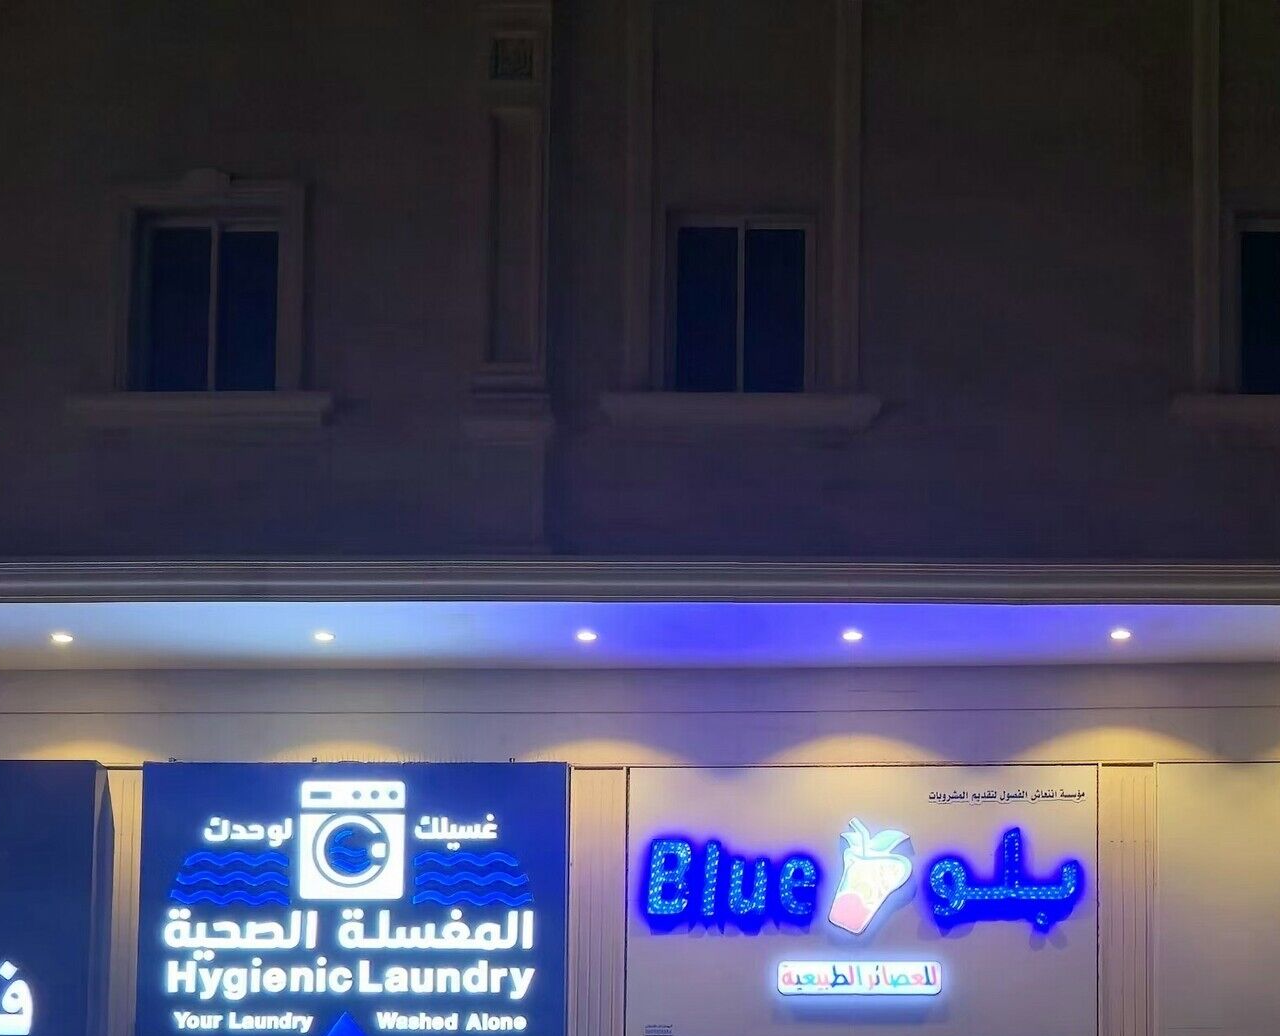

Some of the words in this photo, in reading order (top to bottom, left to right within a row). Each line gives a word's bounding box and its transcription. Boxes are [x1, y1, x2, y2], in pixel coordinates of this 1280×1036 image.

[204, 816, 293, 847] لوحدك
[415, 813, 498, 851] غسيلك
[646, 838, 819, 916] Blue
[928, 826, 1079, 926] بلو
[163, 908, 318, 962] الصحية
[338, 908, 535, 951] المغسلة
[166, 956, 353, 1000] Hygienic
[358, 959, 536, 1000] Laundry
[867, 964, 937, 990] للعصائر
[173, 1011, 223, 1030] Your
[228, 1012, 314, 1033] Laundry
[376, 1012, 458, 1031] Washed
[465, 1012, 528, 1032] Alone
